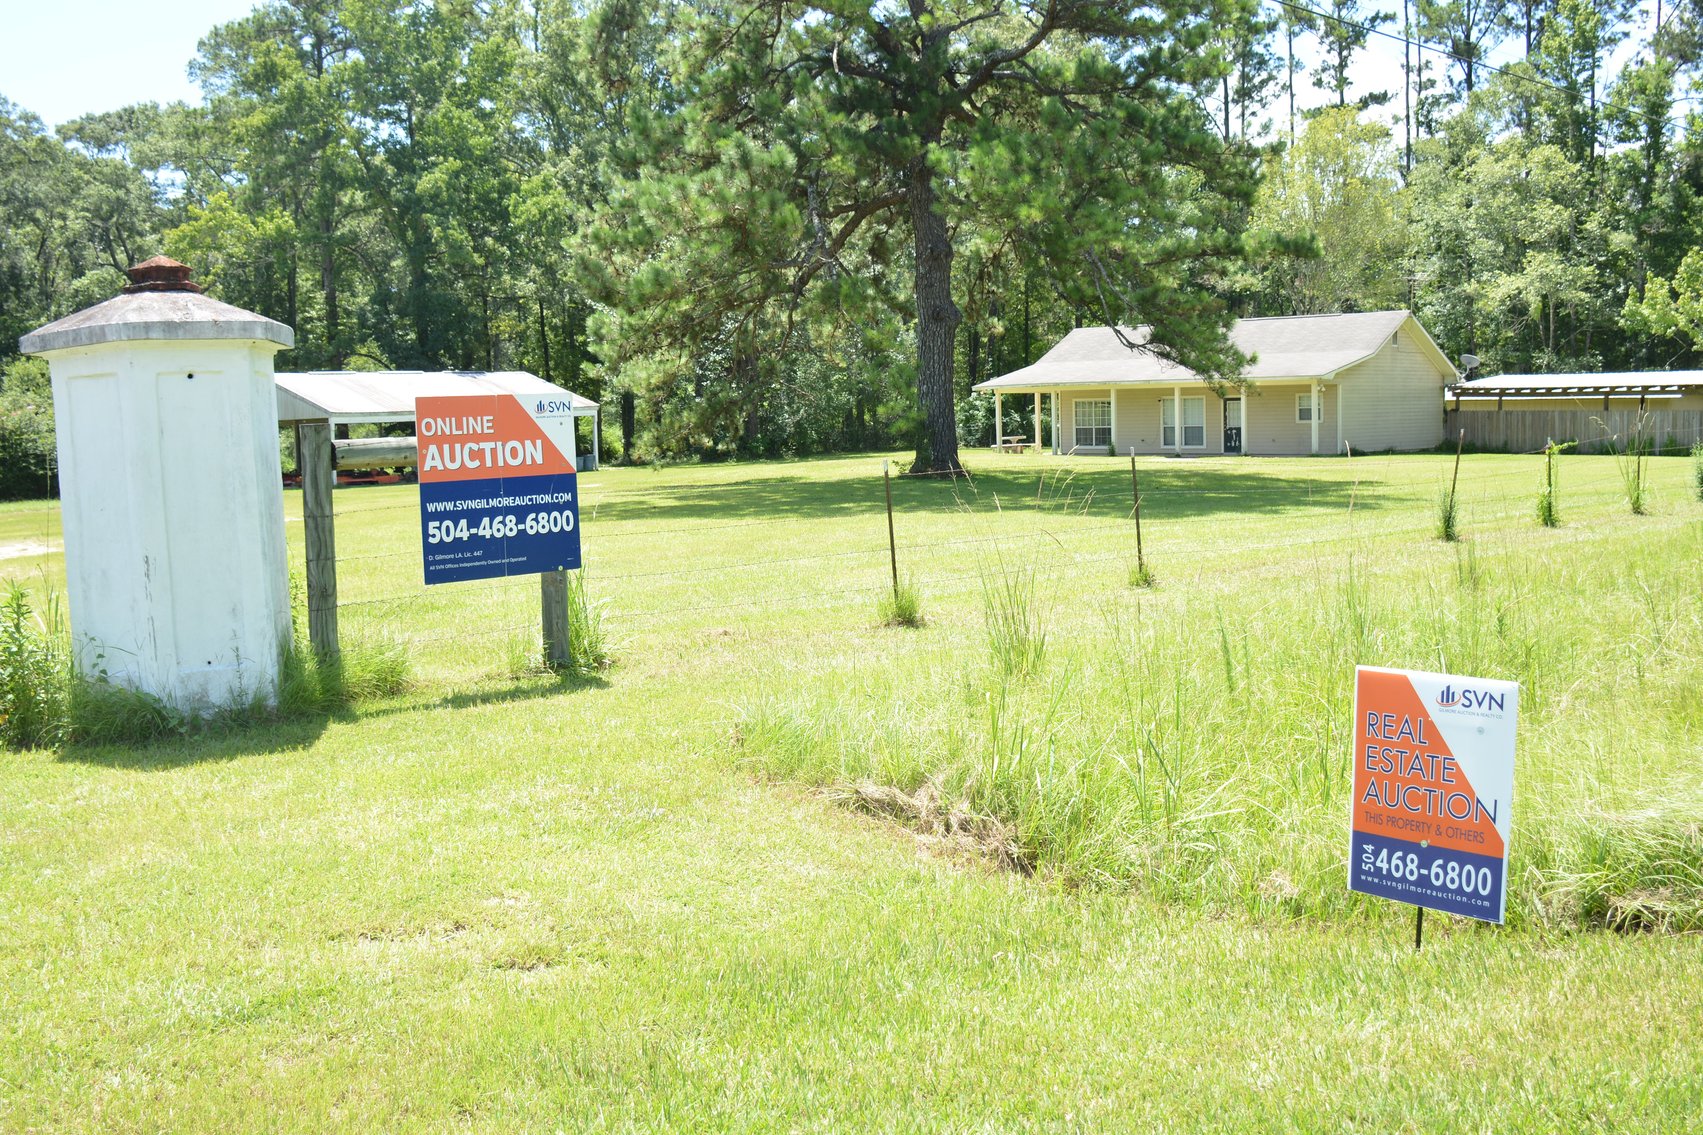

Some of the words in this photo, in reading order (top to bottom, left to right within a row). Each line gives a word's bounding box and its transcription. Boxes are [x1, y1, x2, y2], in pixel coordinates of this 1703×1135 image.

[548, 400, 571, 413] SVN
[421, 416, 495, 436] ONLINE
[423, 439, 544, 471] AUCTION
[426, 492, 572, 512] WWW.SVNGILMOREAUCTION.COM
[428, 510, 574, 544] 504-468-6800
[434, 553, 454, 561] Gilmore
[1461, 689, 1505, 712] SVN
[1366, 710, 1429, 746] REAL
[1365, 744, 1457, 784] ESTATE
[1362, 776, 1498, 825] AUCTION
[1364, 810, 1383, 826] THIS
[1386, 815, 1432, 834] PROPERTY
[1434, 824, 1443, 837] &
[1445, 826, 1485, 844] OTHERS
[1362, 844, 1375, 872] 504
[1375, 848, 1492, 896] 468-6800
[1360, 873, 1490, 907] www.svngilmoreauction.com
